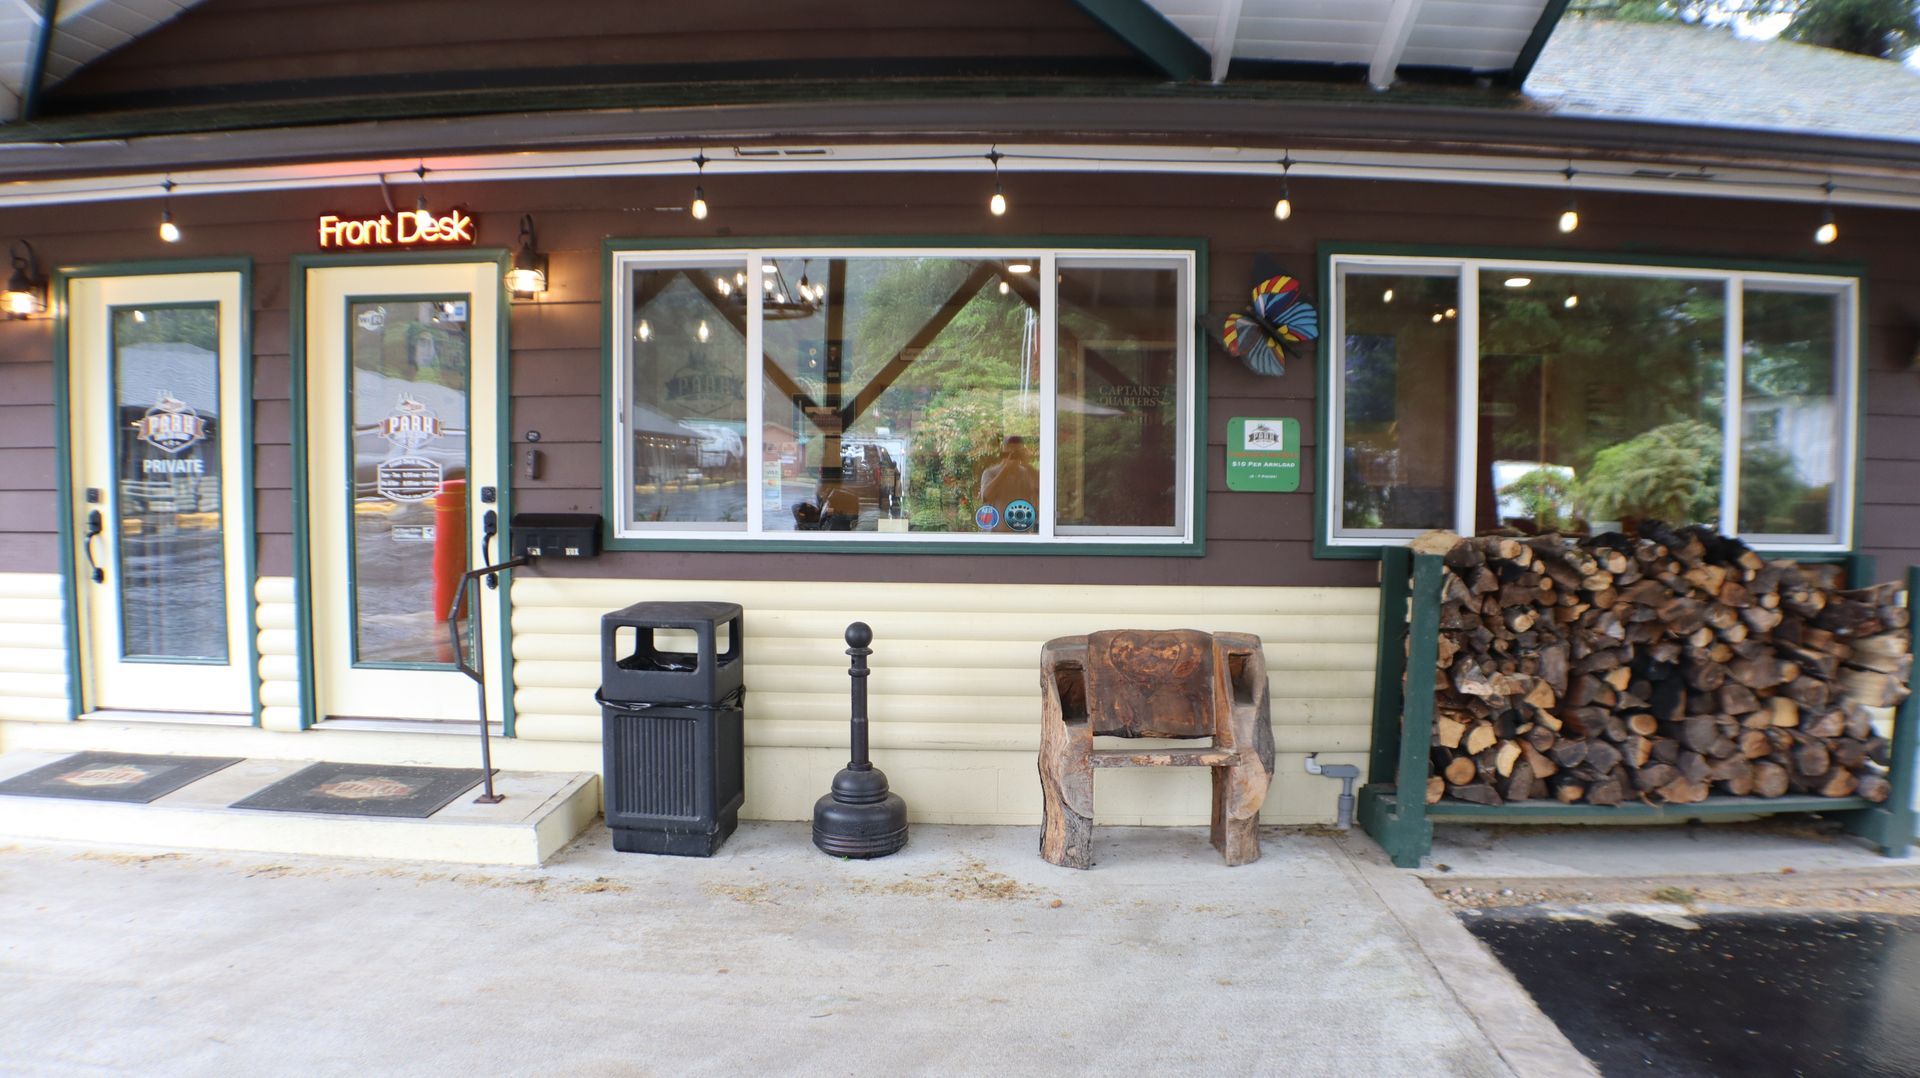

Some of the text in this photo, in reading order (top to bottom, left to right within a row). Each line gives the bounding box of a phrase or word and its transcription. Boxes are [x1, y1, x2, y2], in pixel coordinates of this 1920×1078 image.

[319, 210, 471, 247] Front Desk
[143, 459, 205, 473] PRIVATE
